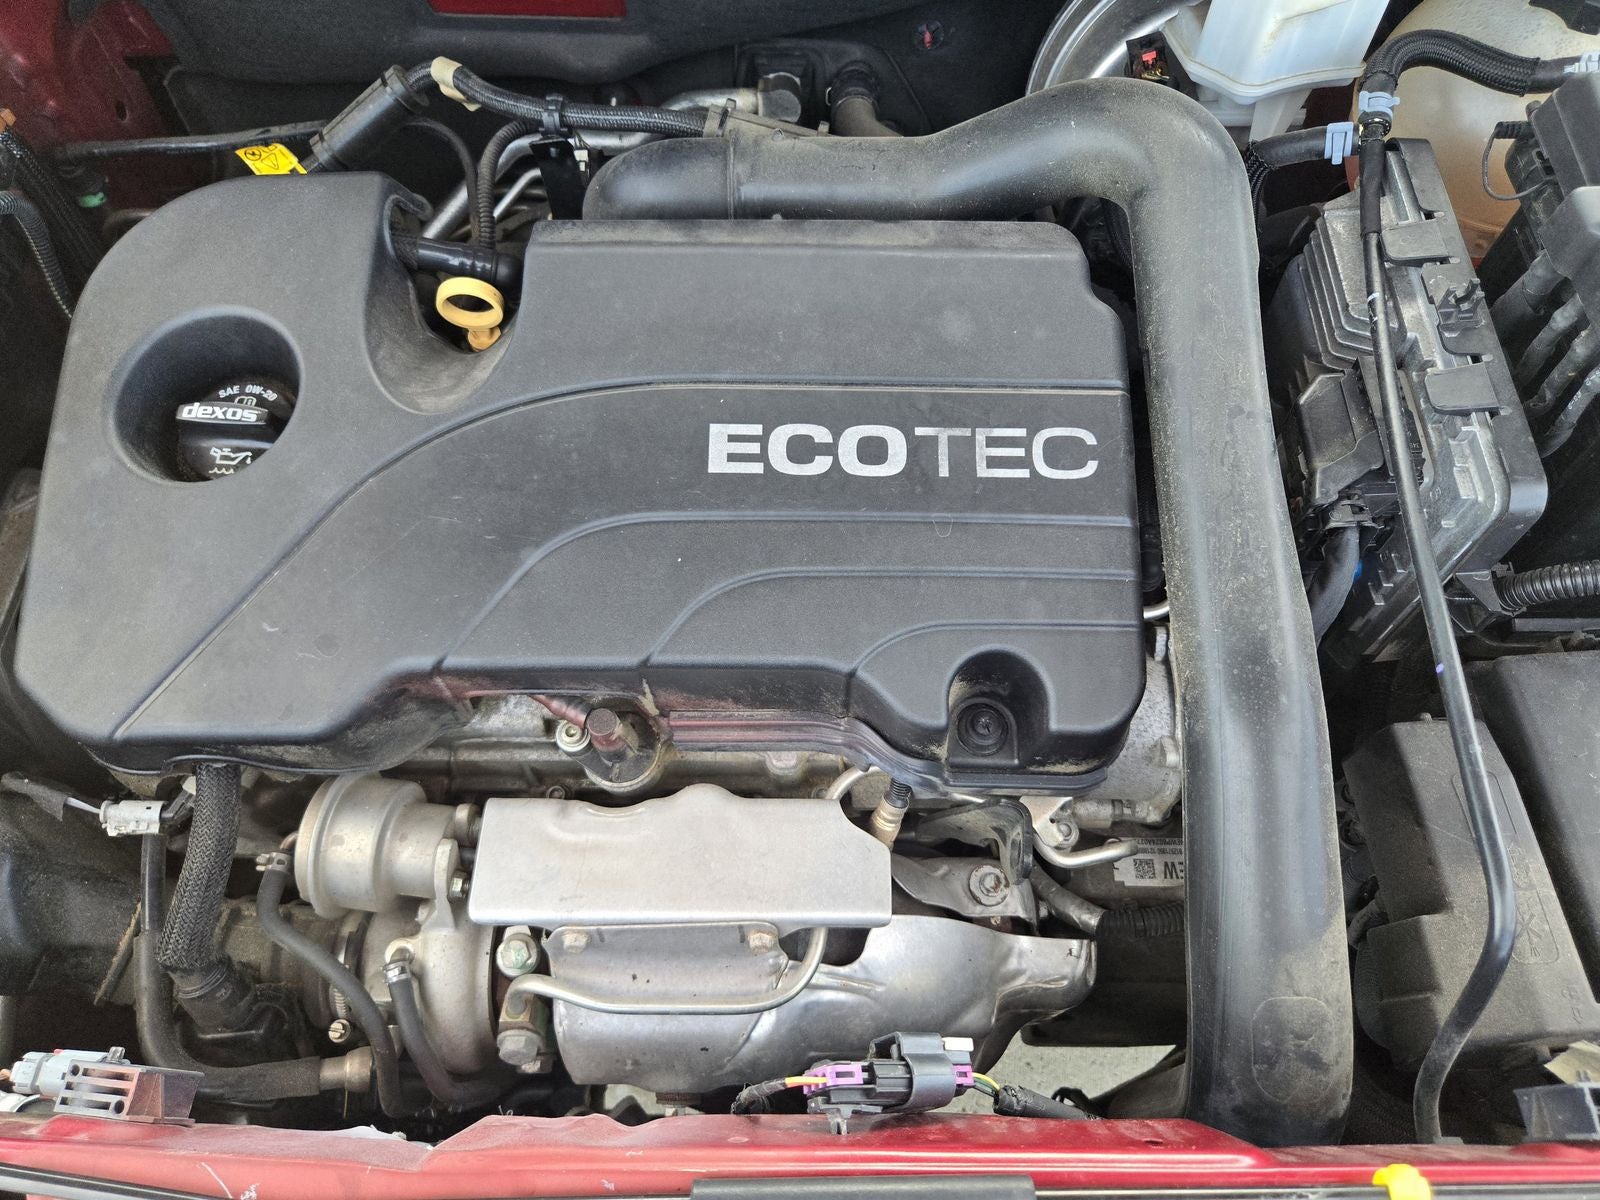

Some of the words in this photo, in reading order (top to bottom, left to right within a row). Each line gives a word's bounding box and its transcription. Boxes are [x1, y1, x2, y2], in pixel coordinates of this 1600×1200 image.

[218, 385, 241, 398] SAE
[245, 384, 278, 401] 0W-20
[182, 402, 259, 422] dexos
[707, 423, 1099, 480] ECOTEC
